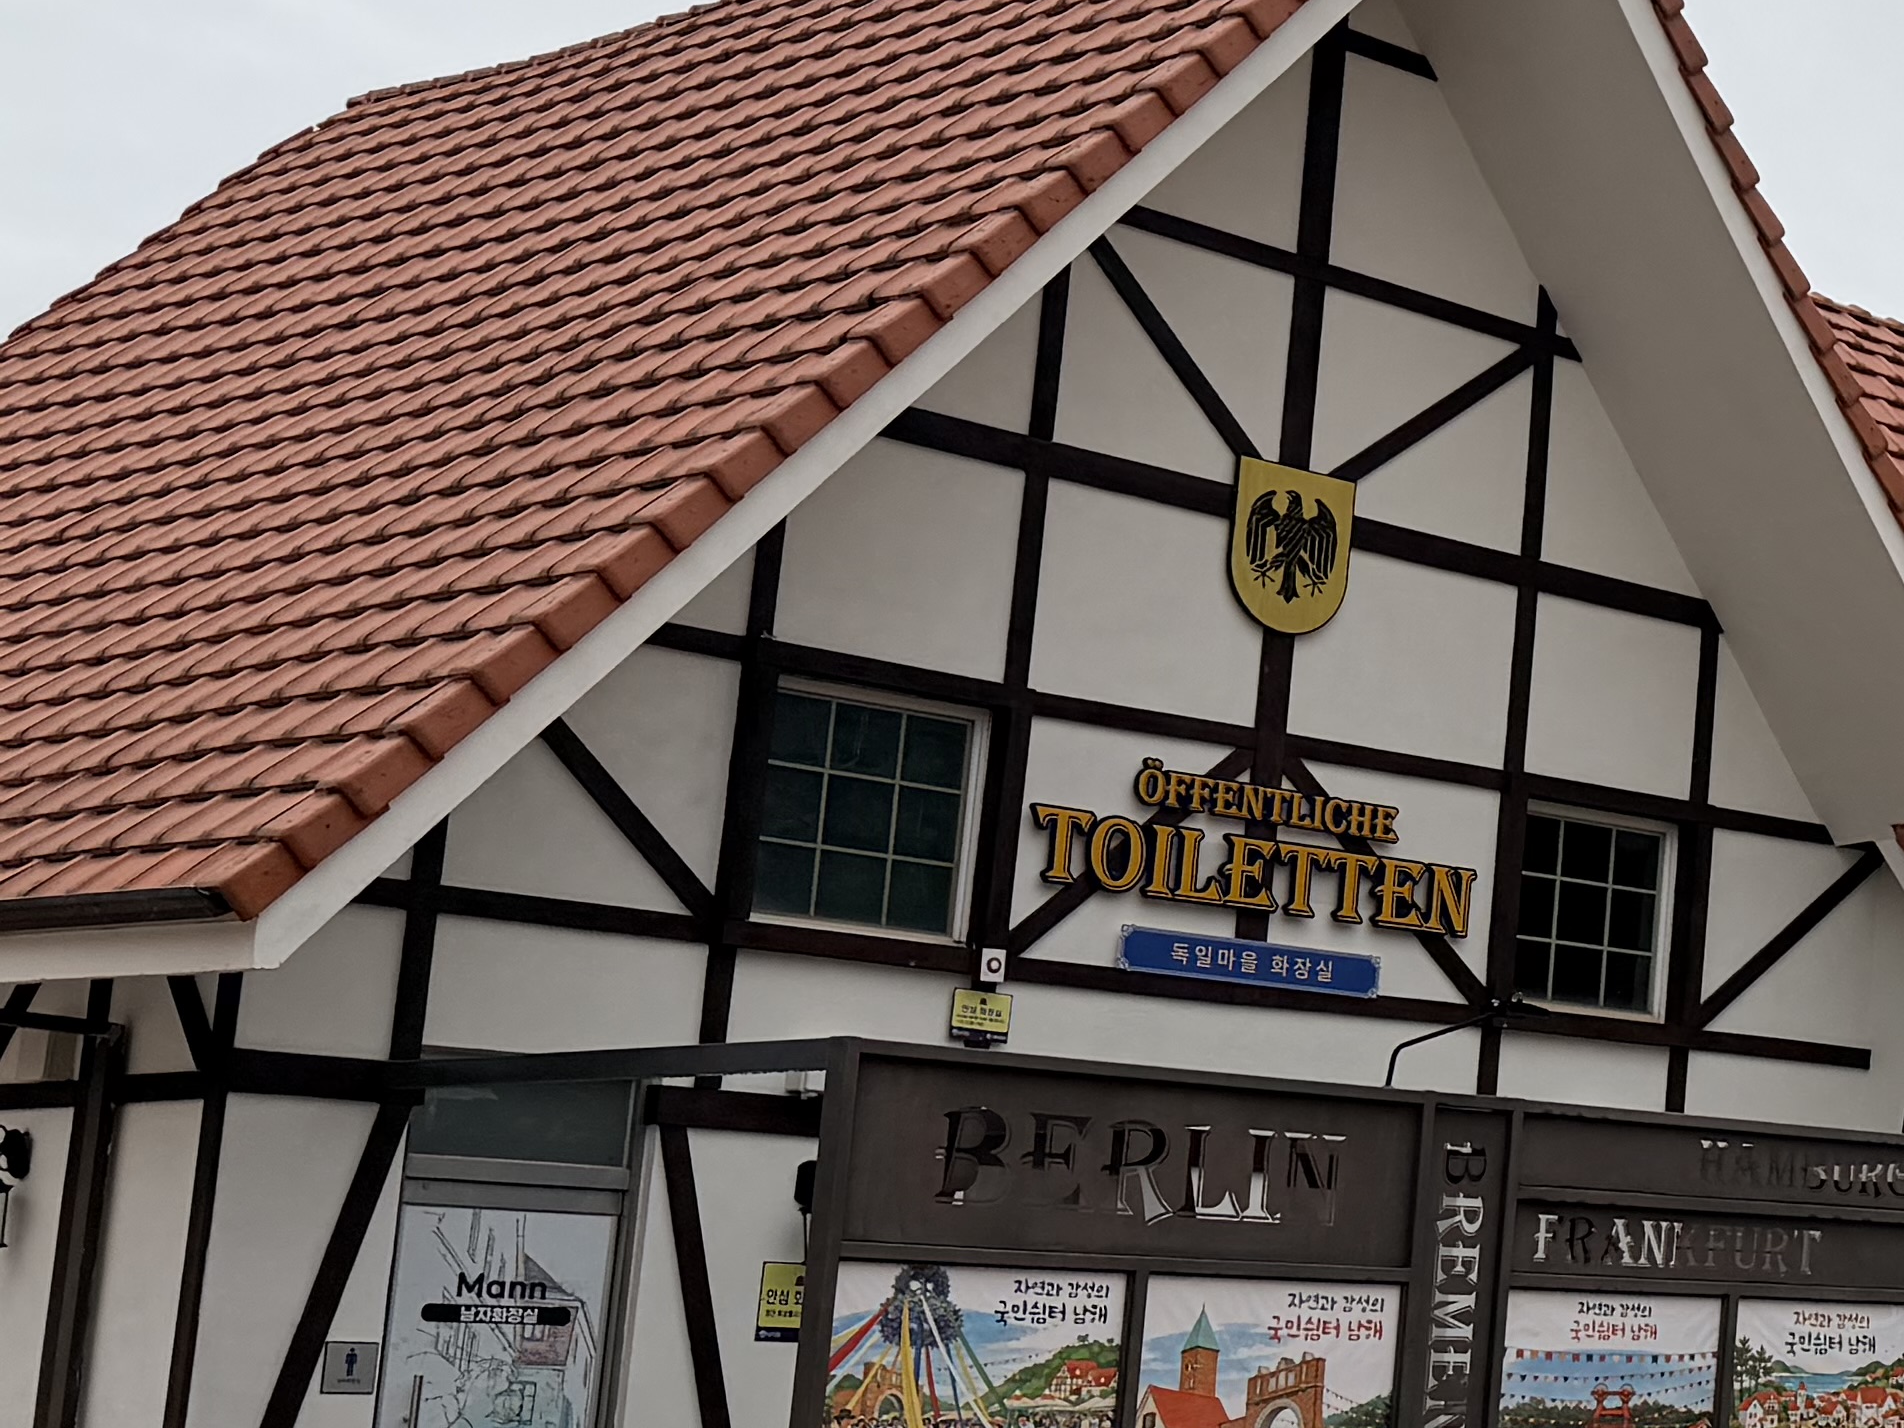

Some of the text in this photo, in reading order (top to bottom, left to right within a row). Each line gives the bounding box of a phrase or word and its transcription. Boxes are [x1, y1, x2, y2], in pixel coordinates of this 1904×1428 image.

[1137, 756, 1400, 844] ÖFFENTLICHE
[1031, 802, 1477, 938] TOILETTEN
[1171, 942, 1333, 983] 독일마을 화장실
[934, 1105, 1347, 1226] BERLIN
[1533, 1214, 1822, 1277] FRANKFURT
[456, 1272, 547, 1300] Mann
[1014, 1278, 1110, 1299] 자연과 감성의
[460, 1306, 539, 1324] 남자화장실
[994, 1300, 1108, 1327] 국민쉼터 남해
[1288, 1292, 1384, 1313] 자연과 감성의
[1267, 1314, 1383, 1344] 국민쉼터 남해
[1570, 1319, 1657, 1343] 국민쉼터 남해
[1793, 1310, 1870, 1329] 자연과 감성의
[1785, 1331, 1876, 1357] 국민쉼터 남해
